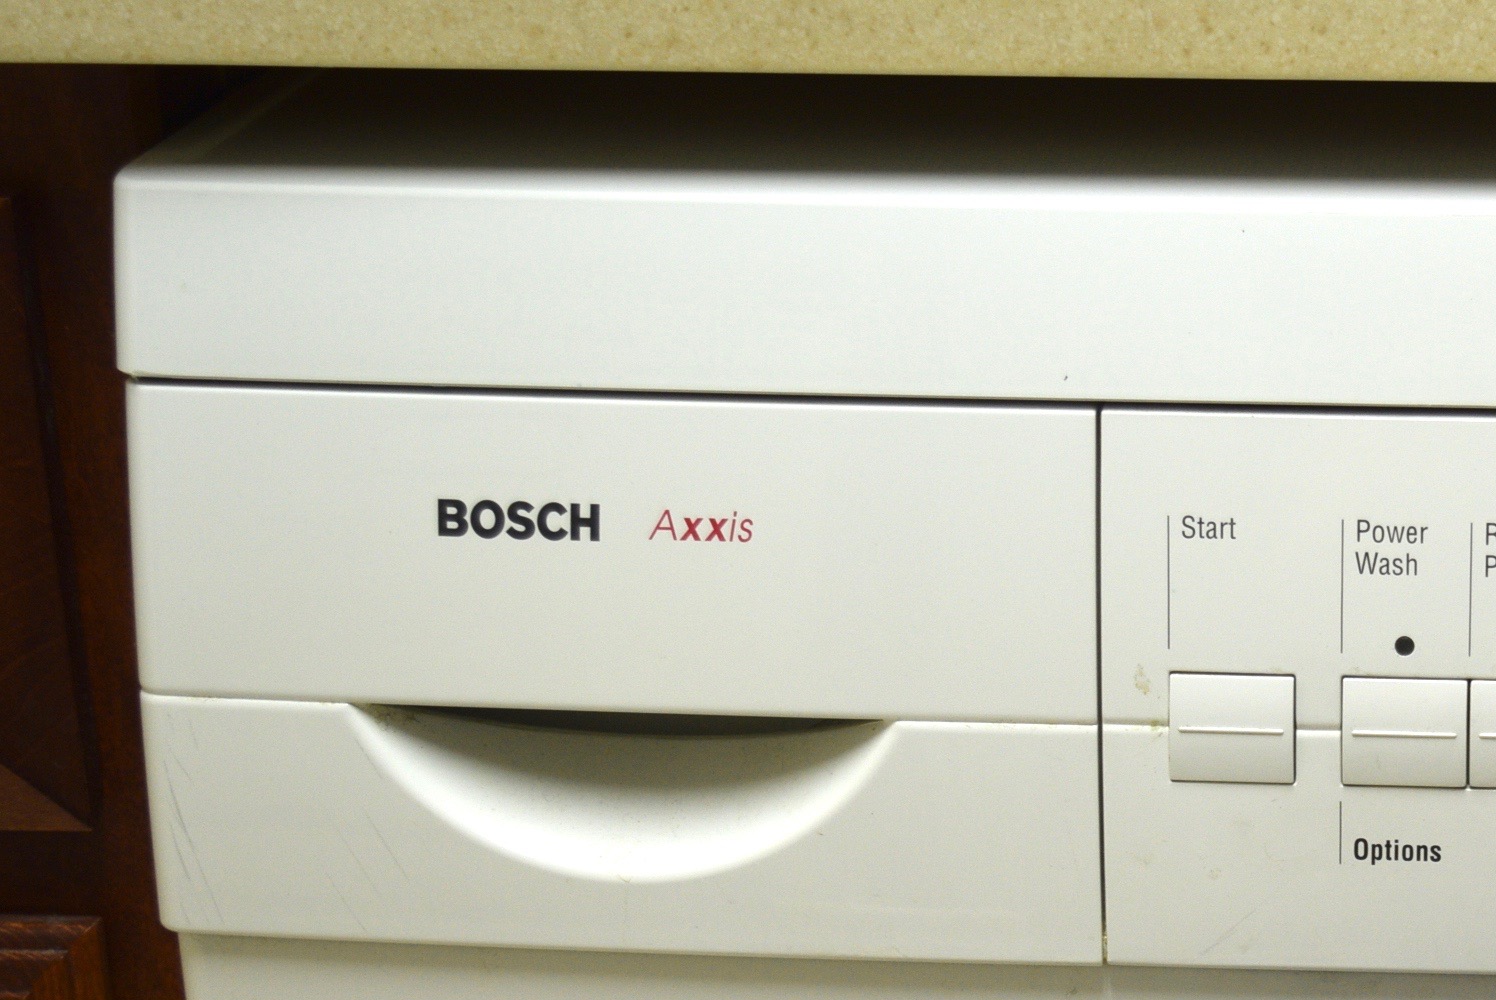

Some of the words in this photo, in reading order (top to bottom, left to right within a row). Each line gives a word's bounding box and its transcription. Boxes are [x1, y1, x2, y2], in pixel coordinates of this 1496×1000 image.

[436, 497, 601, 543] BOSCH
[648, 508, 754, 544] Axxis
[1181, 514, 1237, 540] Start
[1356, 518, 1429, 545] Power
[1354, 550, 1418, 577] Wash
[1353, 837, 1442, 866] Options
